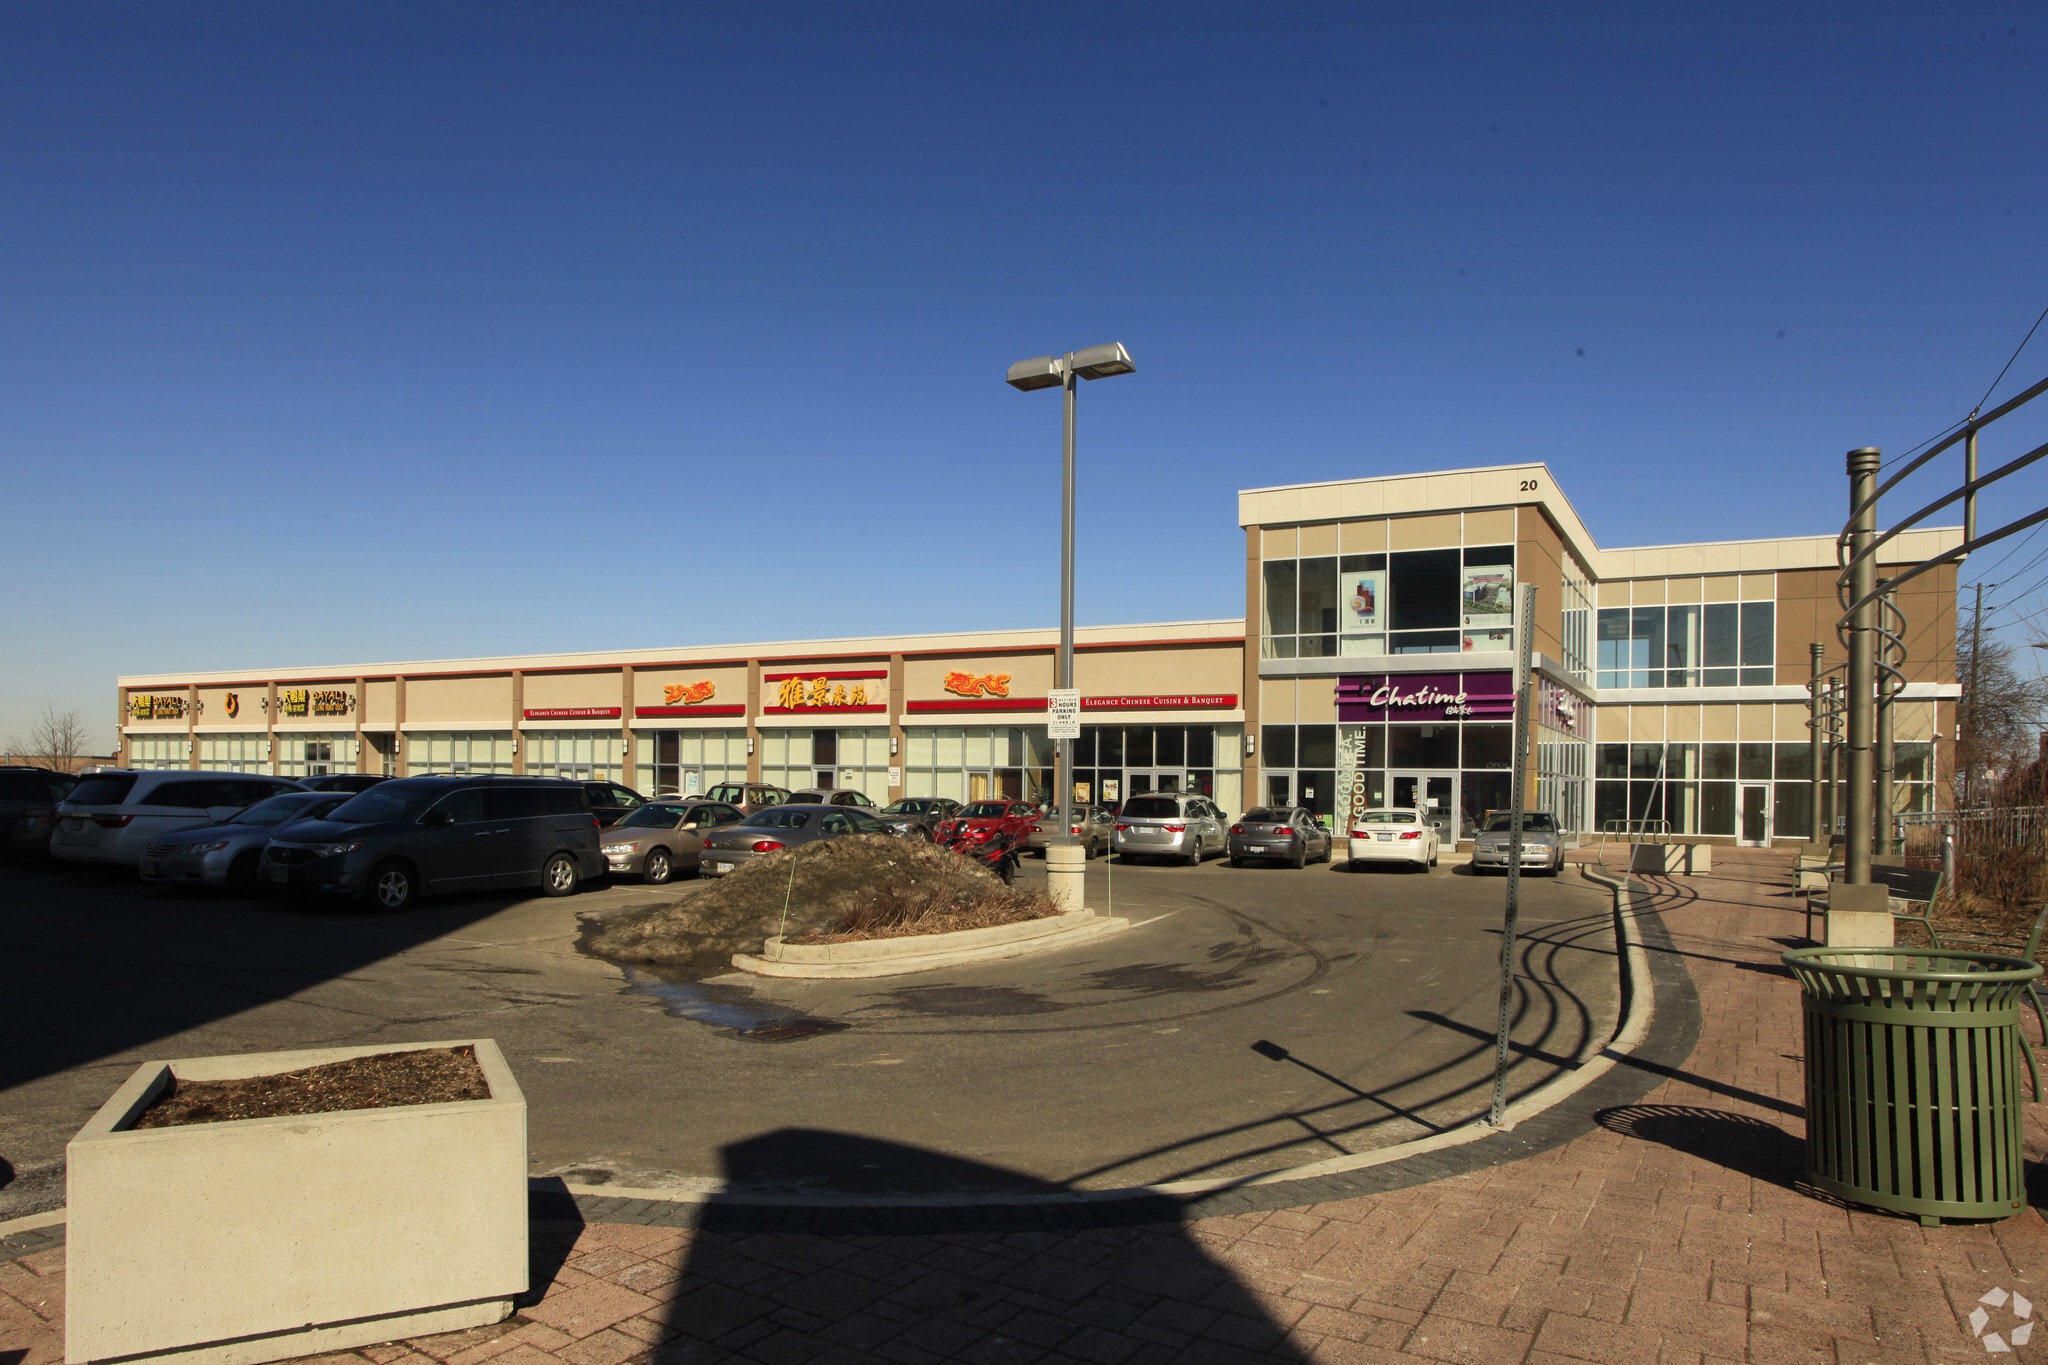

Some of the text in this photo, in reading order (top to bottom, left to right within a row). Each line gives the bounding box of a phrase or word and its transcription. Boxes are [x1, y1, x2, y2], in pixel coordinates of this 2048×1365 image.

[1520, 480, 1537, 491] 20
[312, 690, 343, 700] DAYALI
[1370, 685, 1467, 706] Chatime
[1050, 698, 1057, 708] 3
[1085, 698, 1118, 706] ELEGANCE
[1120, 697, 1151, 705] CHINESE
[1183, 696, 1189, 704] &
[1191, 696, 1224, 704] BANQUET
[1353, 726, 1366, 818] GOOD TIME.
